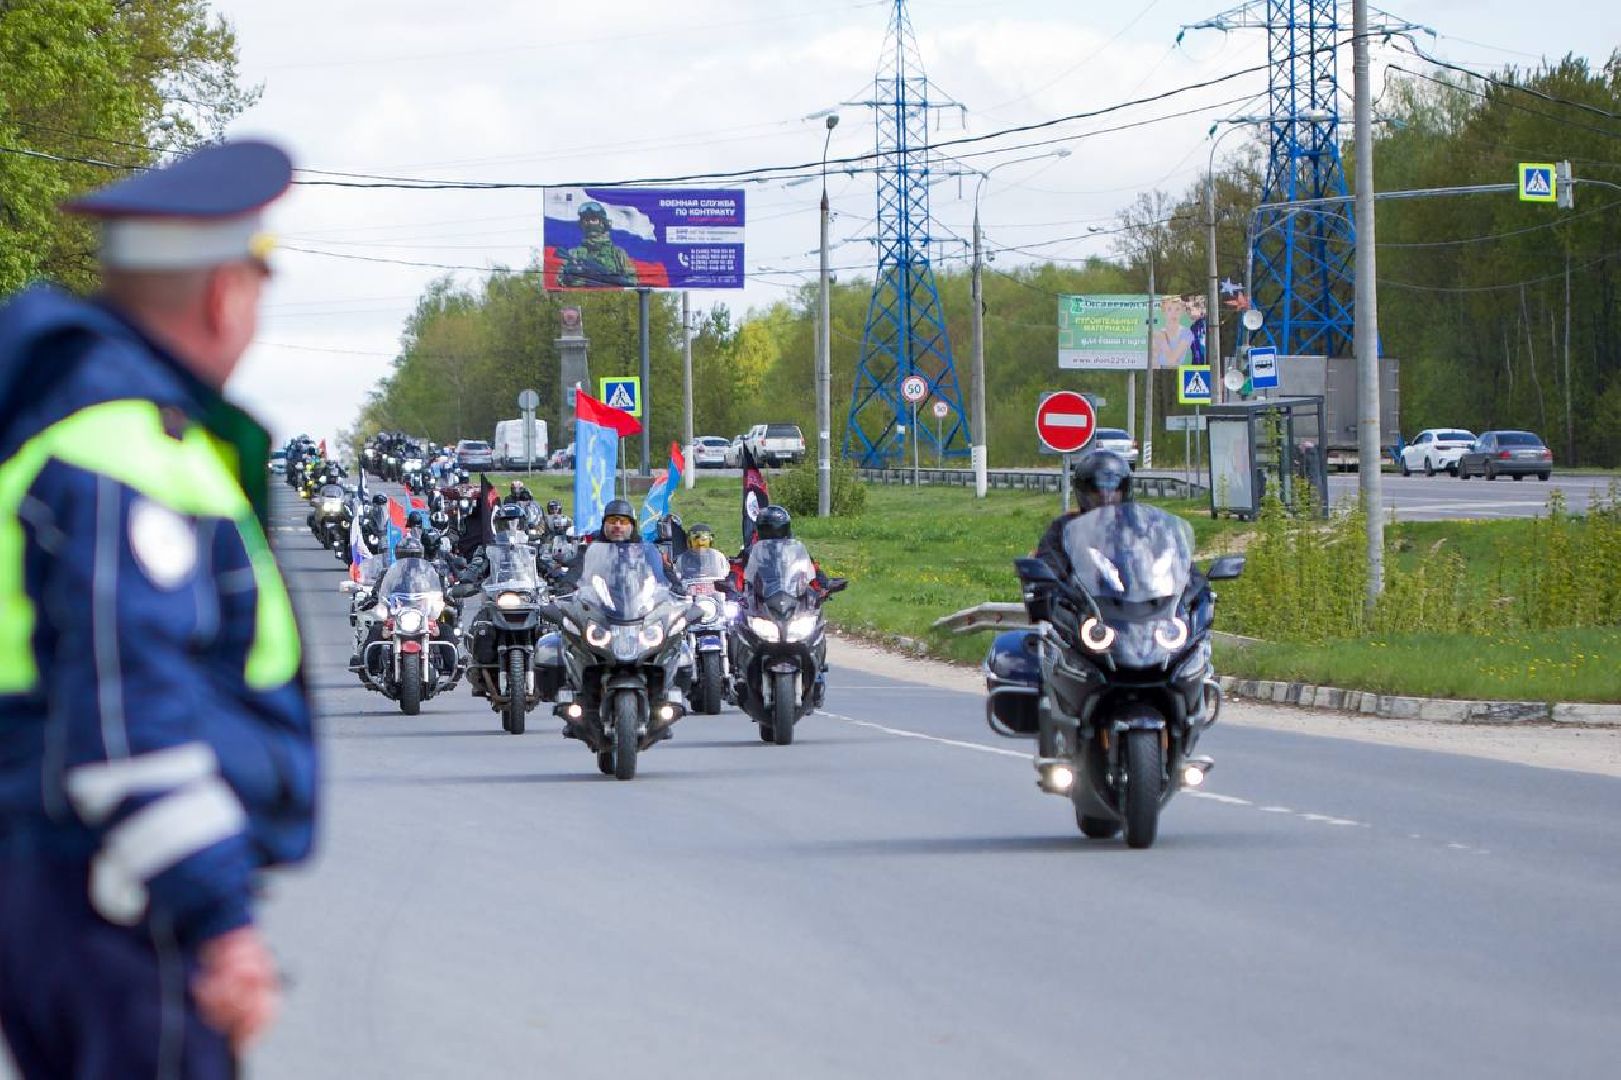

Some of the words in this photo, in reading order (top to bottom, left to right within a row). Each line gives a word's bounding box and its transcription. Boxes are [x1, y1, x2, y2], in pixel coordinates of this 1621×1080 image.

[675, 208, 687, 216] ПО
[689, 208, 735, 216] КОНТРАКТУ
[908, 384, 920, 393] 50
